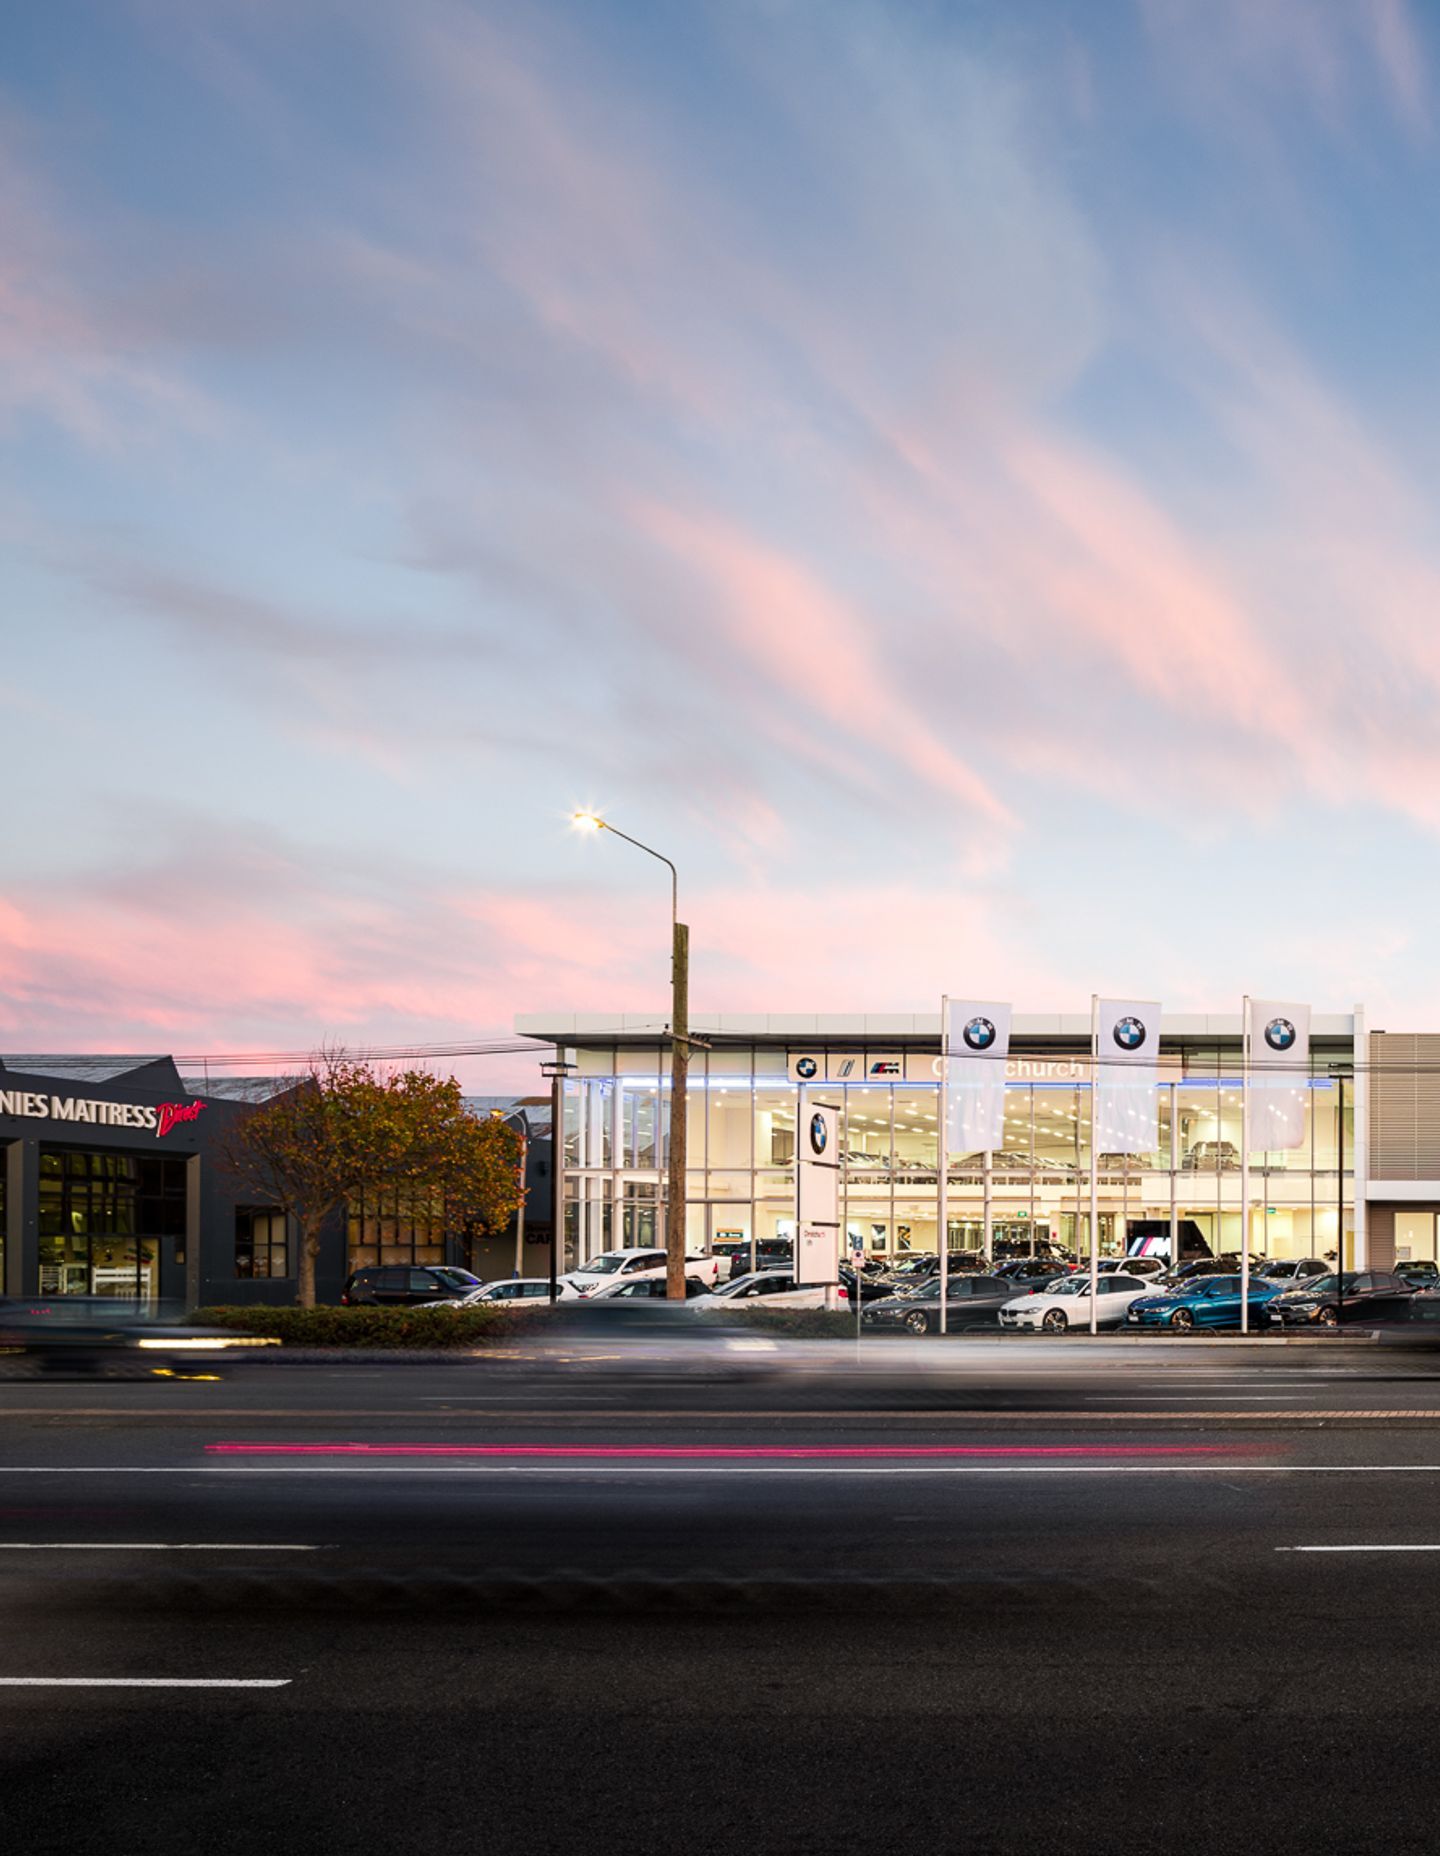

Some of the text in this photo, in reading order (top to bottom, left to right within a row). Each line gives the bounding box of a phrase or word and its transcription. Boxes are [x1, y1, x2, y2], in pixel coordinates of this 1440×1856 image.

[931, 1055, 1084, 1077] Cchurch
[51, 1095, 158, 1130] MATTRESS
[156, 1099, 208, 1138] Direct
